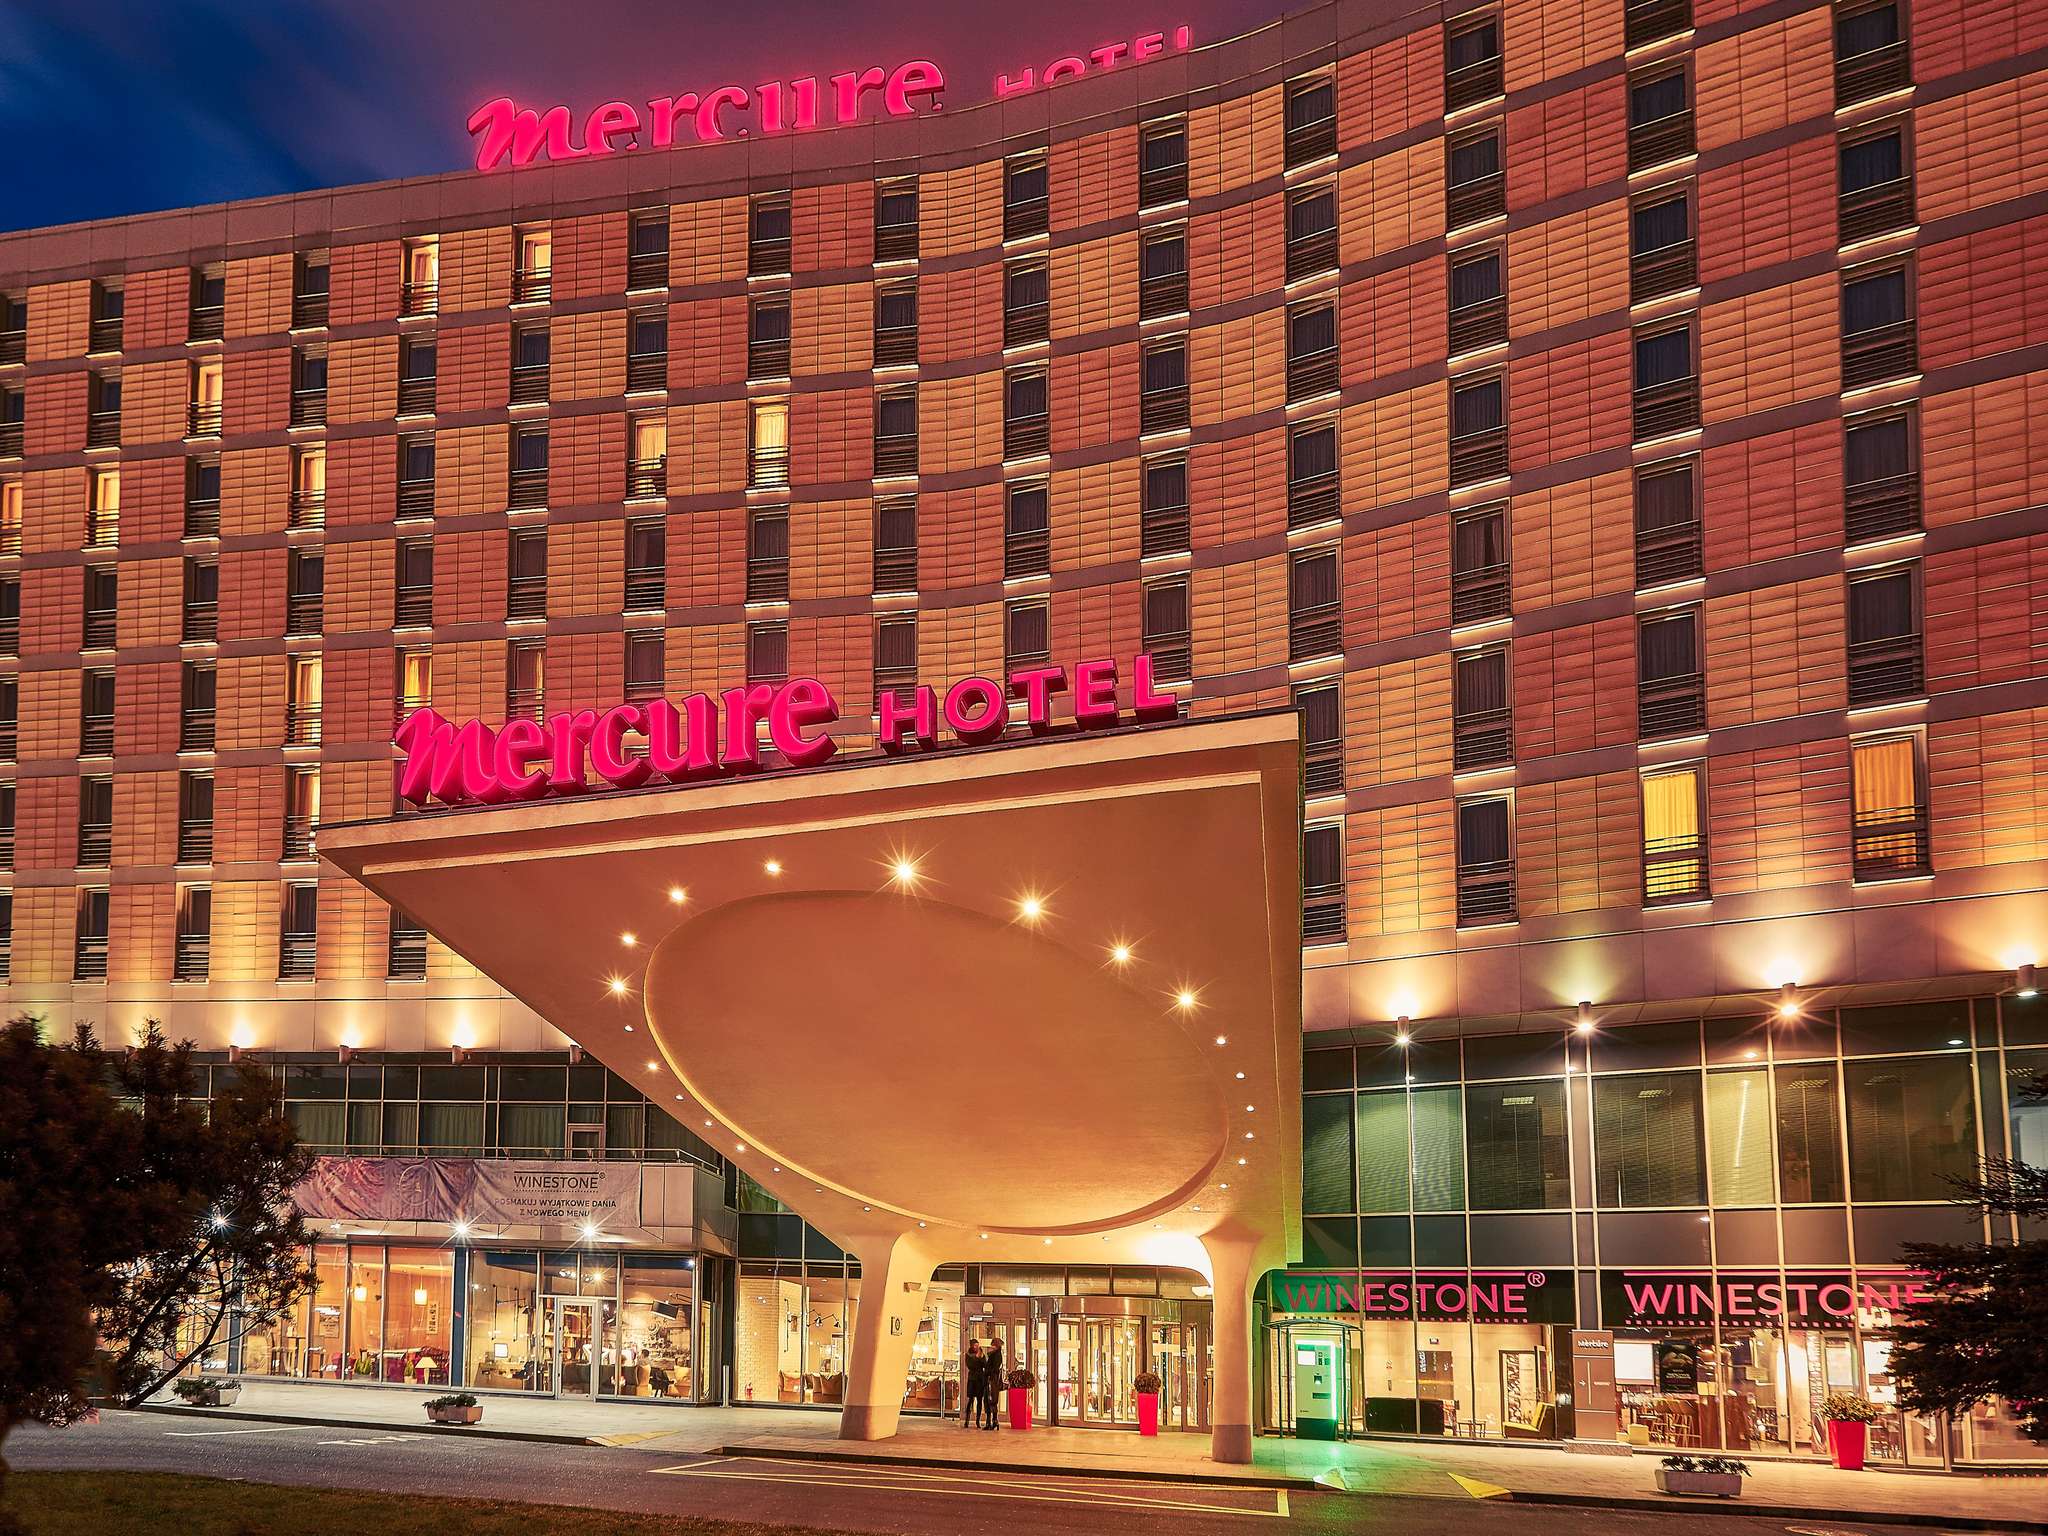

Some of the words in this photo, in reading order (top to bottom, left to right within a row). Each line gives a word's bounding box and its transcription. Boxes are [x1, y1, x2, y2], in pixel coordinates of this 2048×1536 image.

[467, 58, 945, 171] mercure
[394, 677, 839, 806] mercure
[879, 653, 1178, 754] HOTEL
[519, 1208, 525, 1216] Z
[527, 1209, 565, 1217] NOWEGO
[566, 1209, 590, 1217] MENU
[591, 1200, 617, 1208] DANIA
